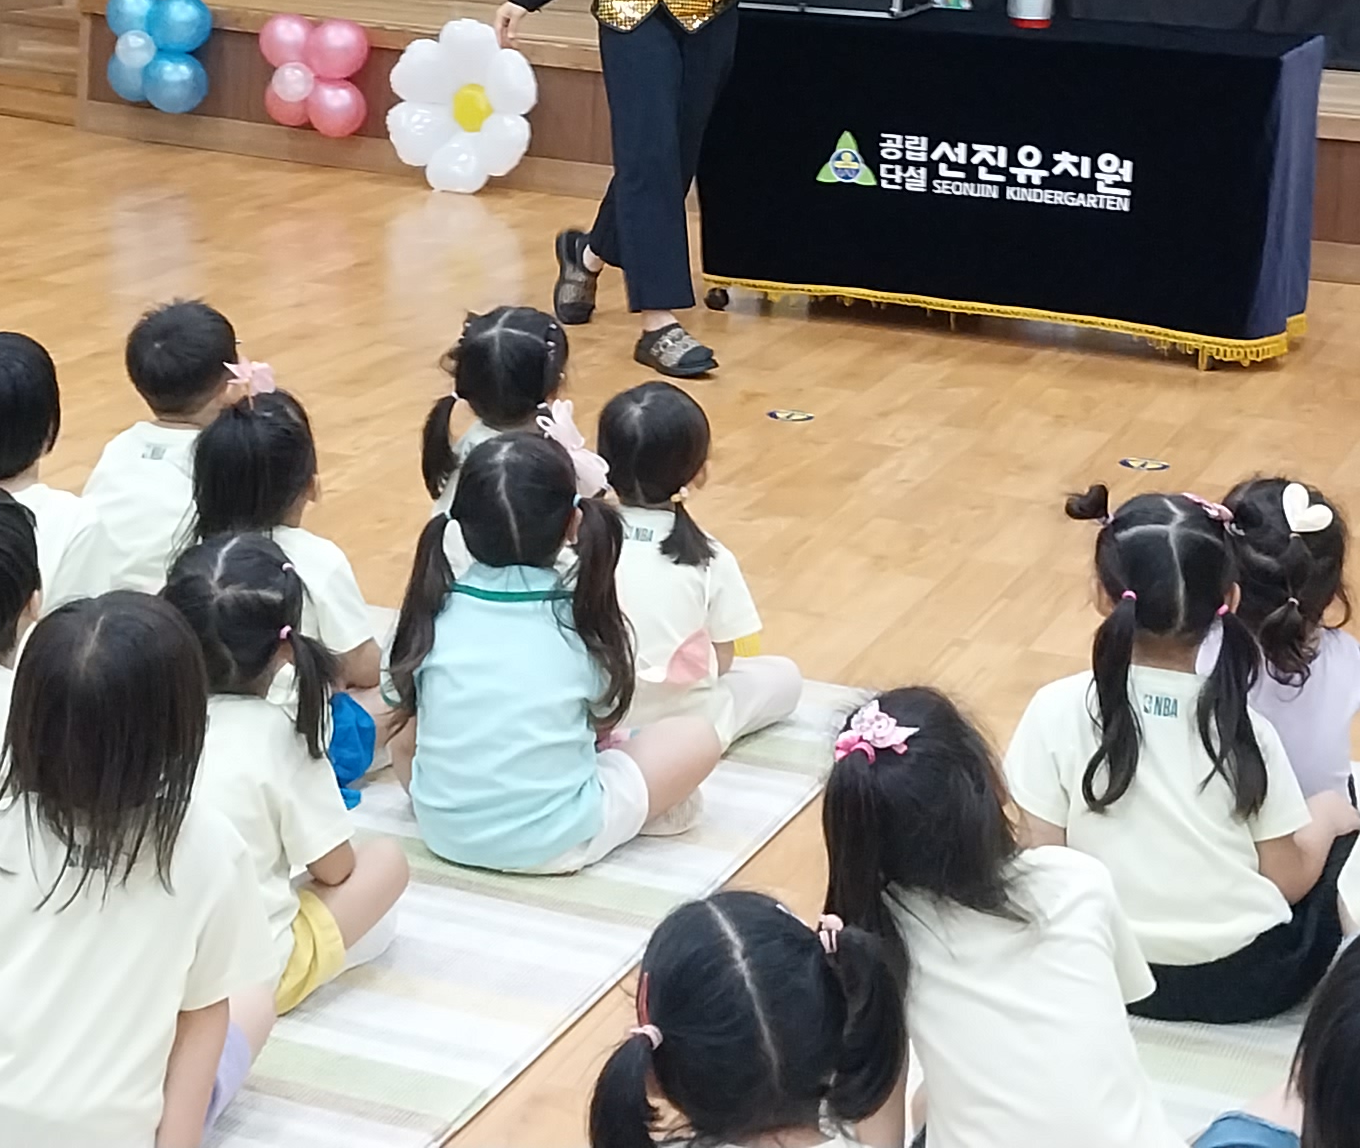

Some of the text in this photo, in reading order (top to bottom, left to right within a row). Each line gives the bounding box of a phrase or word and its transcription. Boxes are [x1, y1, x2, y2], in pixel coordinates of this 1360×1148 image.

[879, 132, 928, 163] 공립
[879, 164, 927, 192] 단설
[930, 140, 1133, 196] 선진유치원
[931, 179, 1131, 212] SEONJIN KINDERGARTEN
[1153, 695, 1178, 718] NBA
